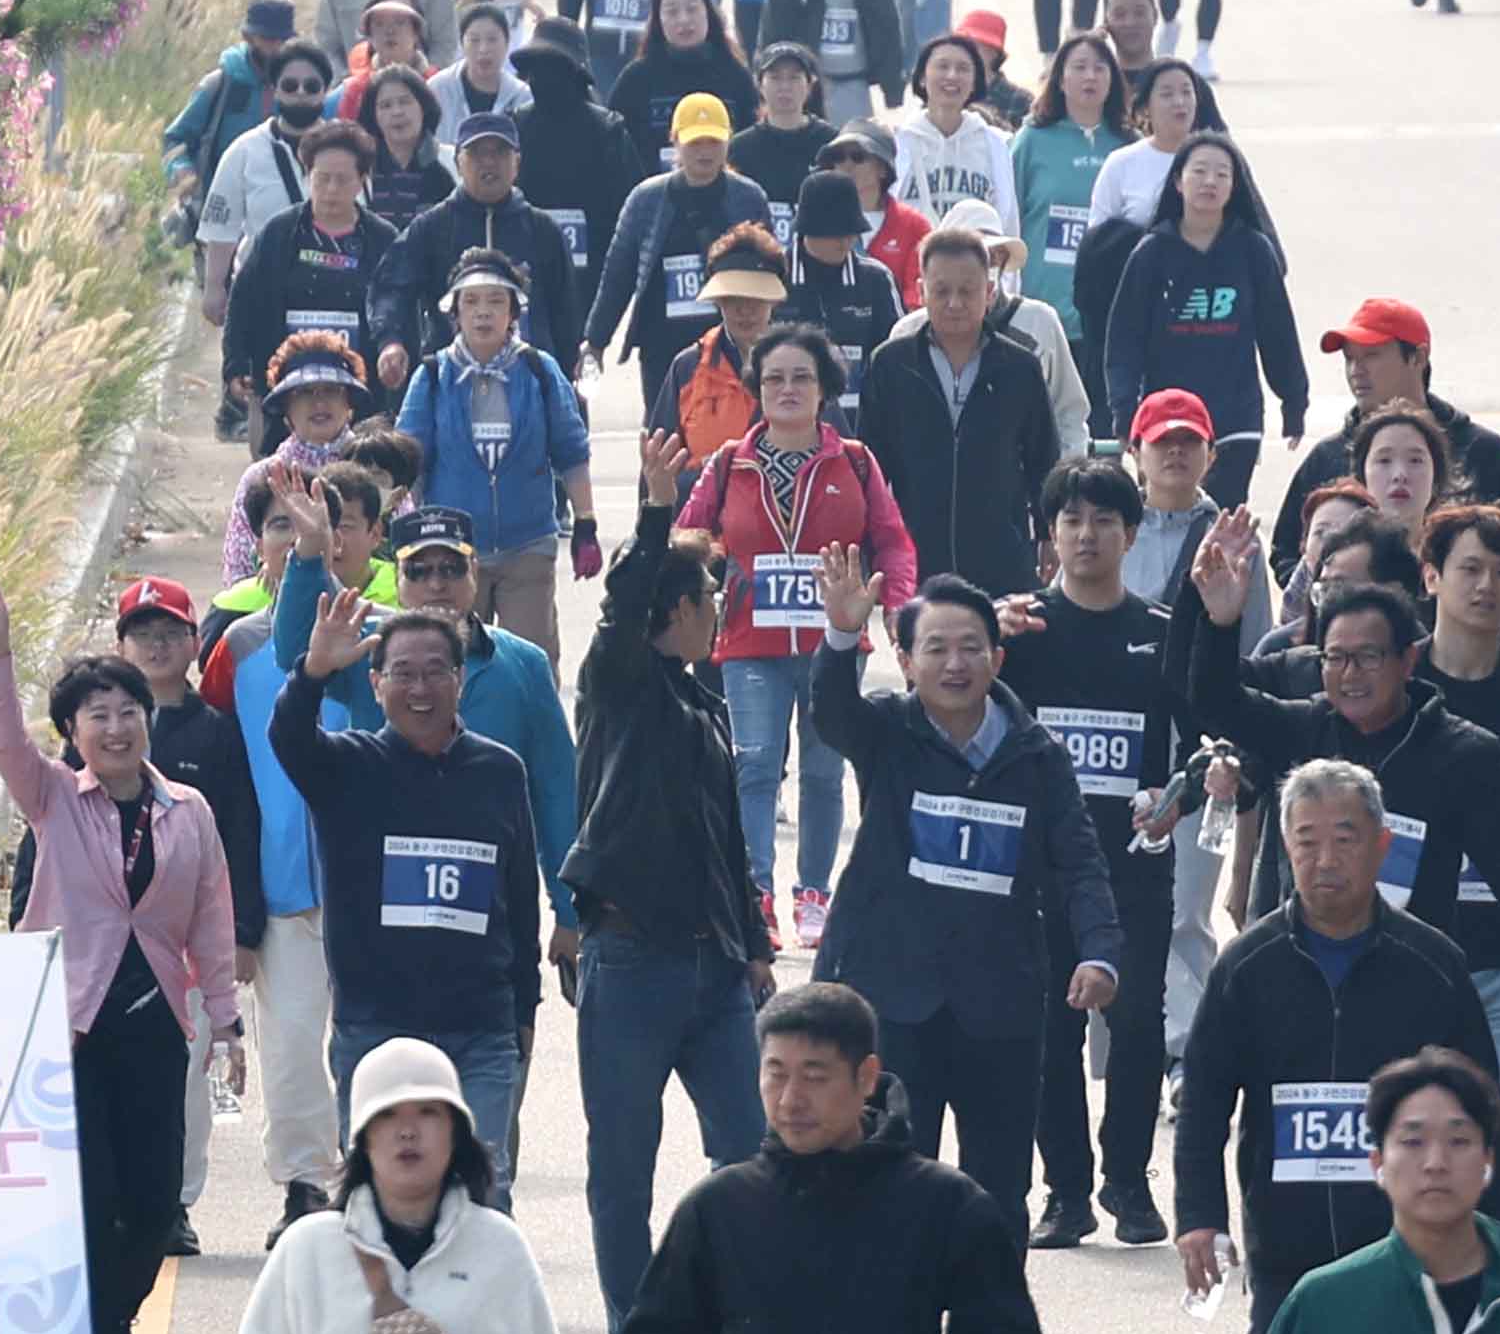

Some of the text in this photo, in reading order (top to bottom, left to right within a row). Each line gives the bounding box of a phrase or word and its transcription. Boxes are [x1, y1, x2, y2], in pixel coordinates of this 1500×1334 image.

[675, 271, 706, 299] 19
[1056, 732, 1130, 772] 989
[958, 824, 971, 861] 1
[424, 863, 461, 902] 16
